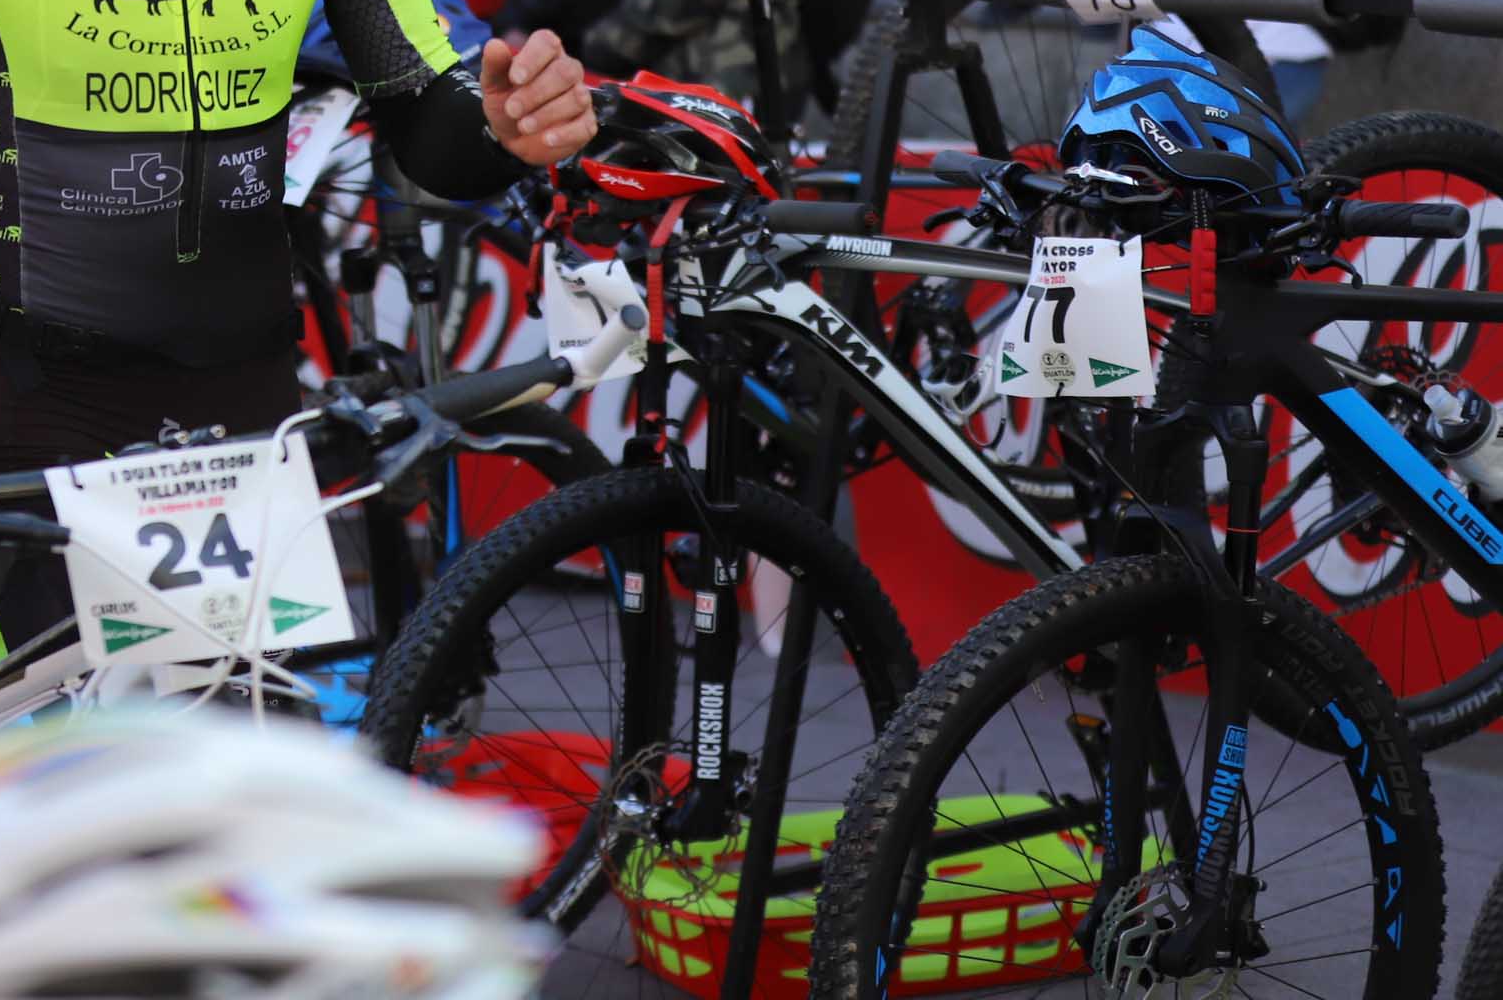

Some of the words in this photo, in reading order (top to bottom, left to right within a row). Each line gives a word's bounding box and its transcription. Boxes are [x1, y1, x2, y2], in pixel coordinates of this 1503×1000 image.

[66, 13, 100, 42] La
[252, 10, 292, 42] S.L.
[85, 68, 266, 114] RODRIGUEZ
[218, 146, 268, 167] AMTEL
[218, 190, 272, 210] TELECO
[826, 234, 892, 257] MYROON
[1051, 245, 1094, 257] CROSS
[1024, 284, 1076, 345] 77
[799, 304, 885, 378] KTM
[1432, 488, 1503, 559] CUBE
[137, 513, 254, 591] 24
[696, 682, 725, 780] ROCKSHOX
